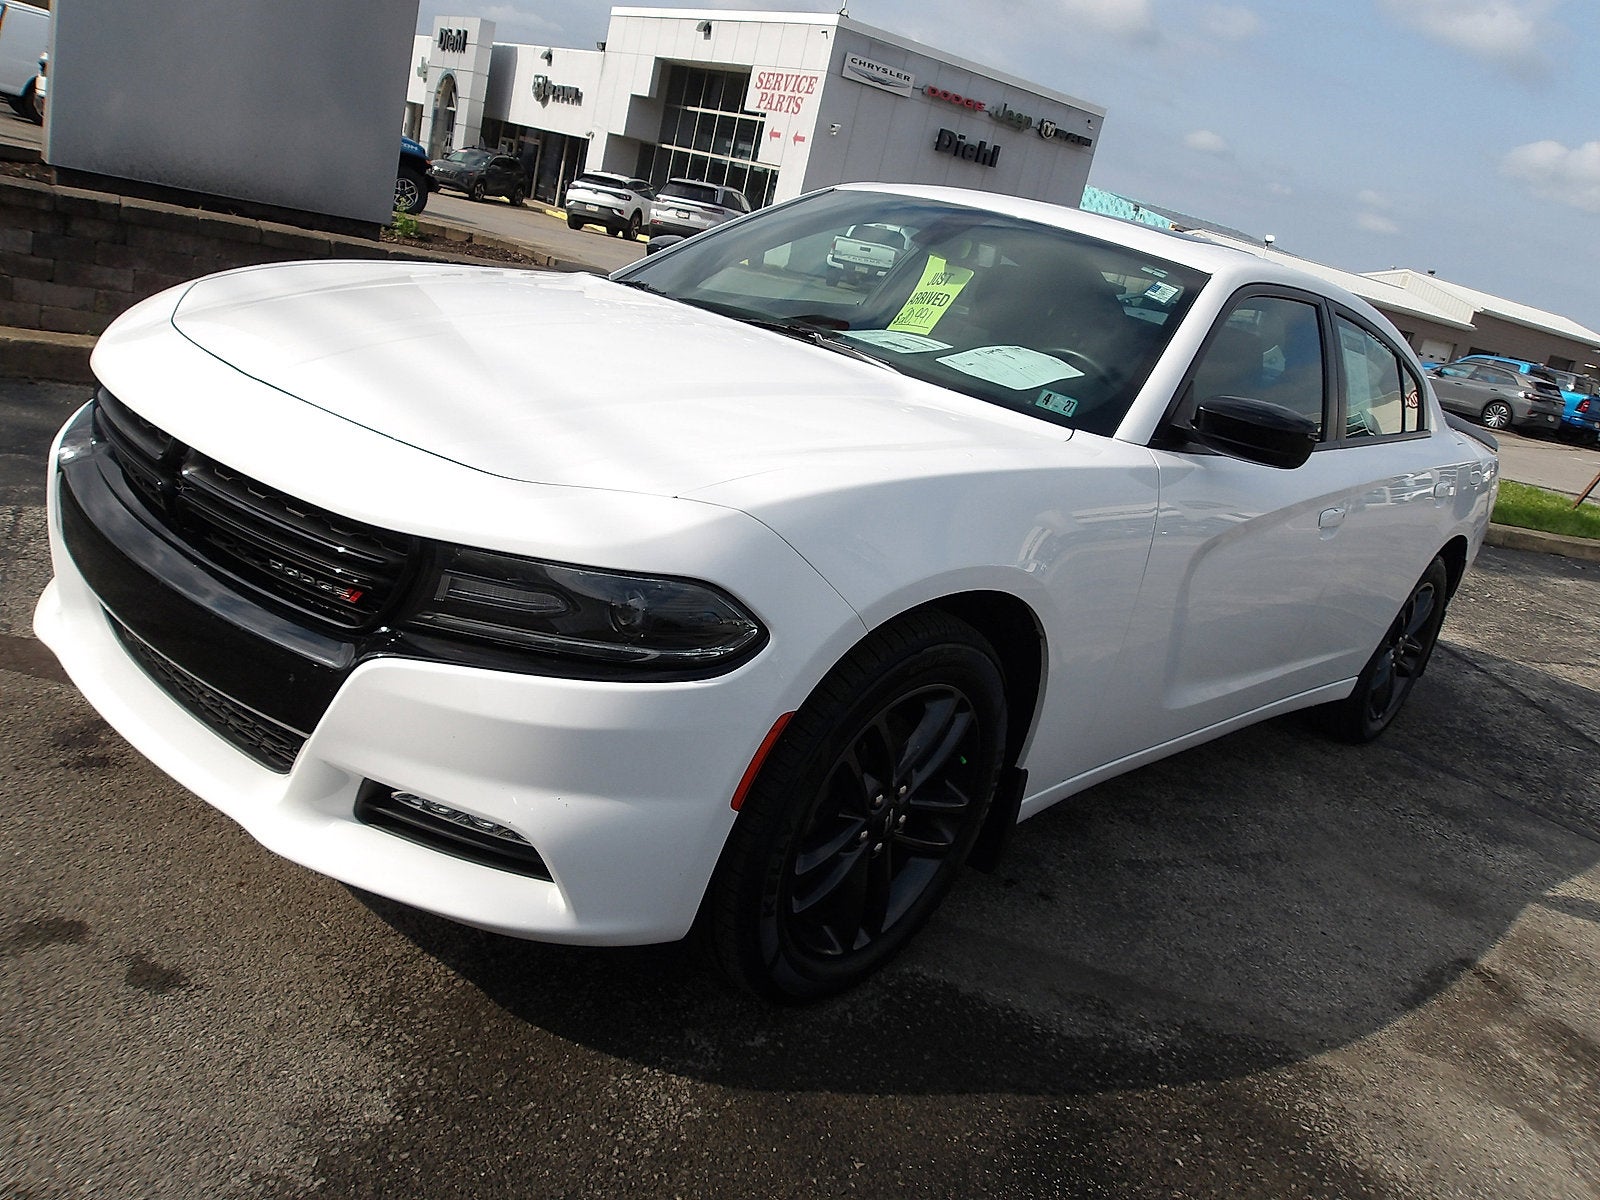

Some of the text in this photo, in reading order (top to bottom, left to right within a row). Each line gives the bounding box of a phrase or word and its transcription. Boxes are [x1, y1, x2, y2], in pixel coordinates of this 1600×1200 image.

[438, 27, 468, 54] Diehl
[850, 57, 911, 82] CHRYSLER
[755, 71, 819, 95] SERVICE
[756, 92, 804, 115] PARTS
[927, 86, 986, 112] DODGE
[995, 103, 1033, 131] Jeep
[935, 128, 1001, 168] Diehl
[926, 271, 955, 287] JUST
[907, 291, 951, 307] ARRIVED
[1042, 393, 1076, 413] 4 27
[269, 559, 351, 598] DODGE
